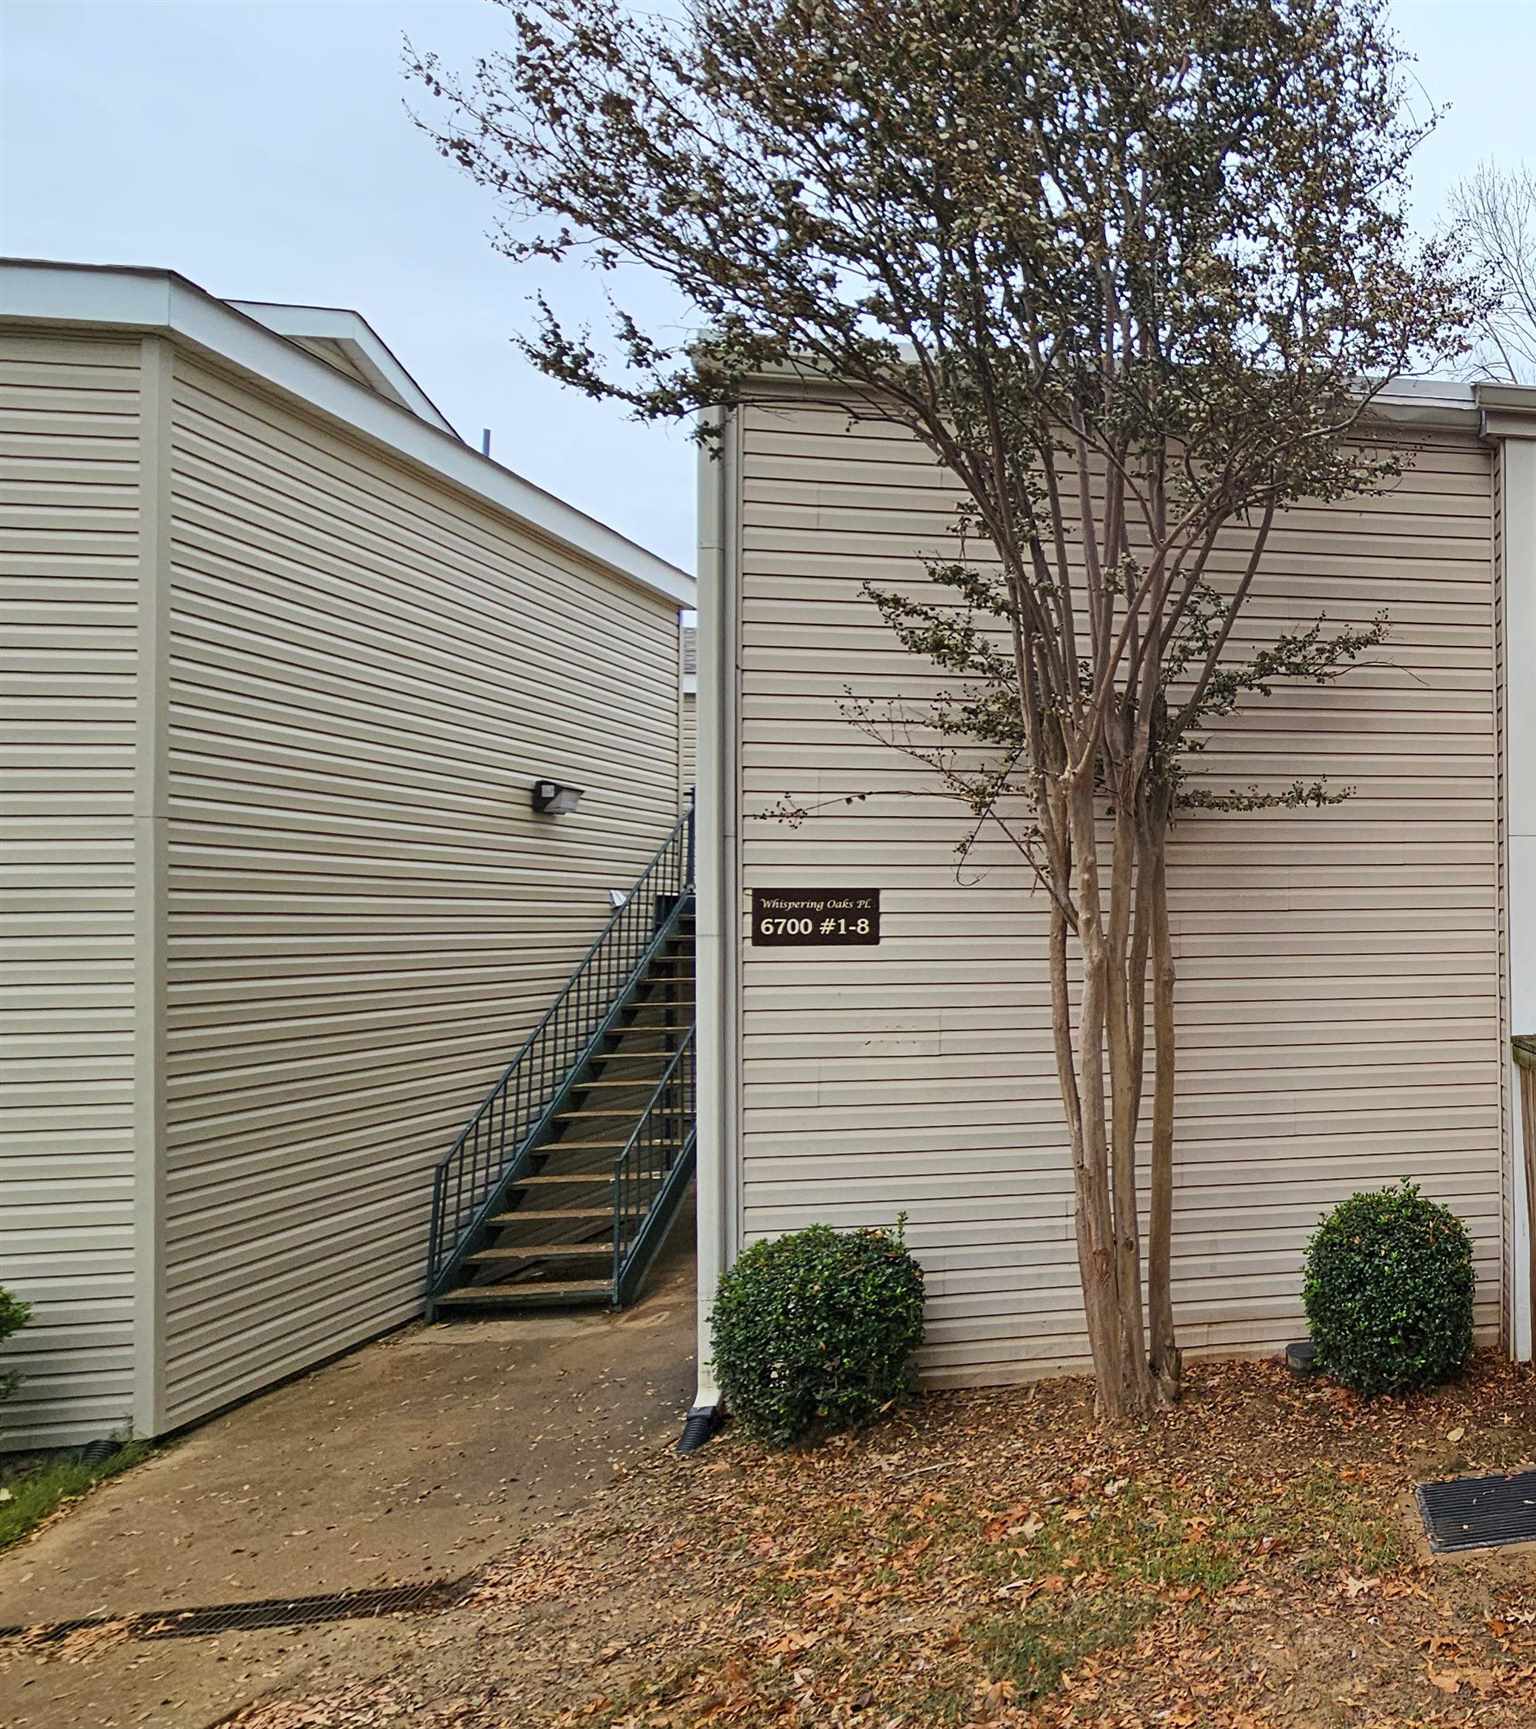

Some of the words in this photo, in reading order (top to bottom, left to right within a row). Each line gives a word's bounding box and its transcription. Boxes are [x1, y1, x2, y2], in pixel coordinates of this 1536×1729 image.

[760, 898, 824, 911] Whispering
[826, 898, 853, 908] Oaks
[761, 918, 812, 935] 6700
[819, 918, 870, 935] #1-8
